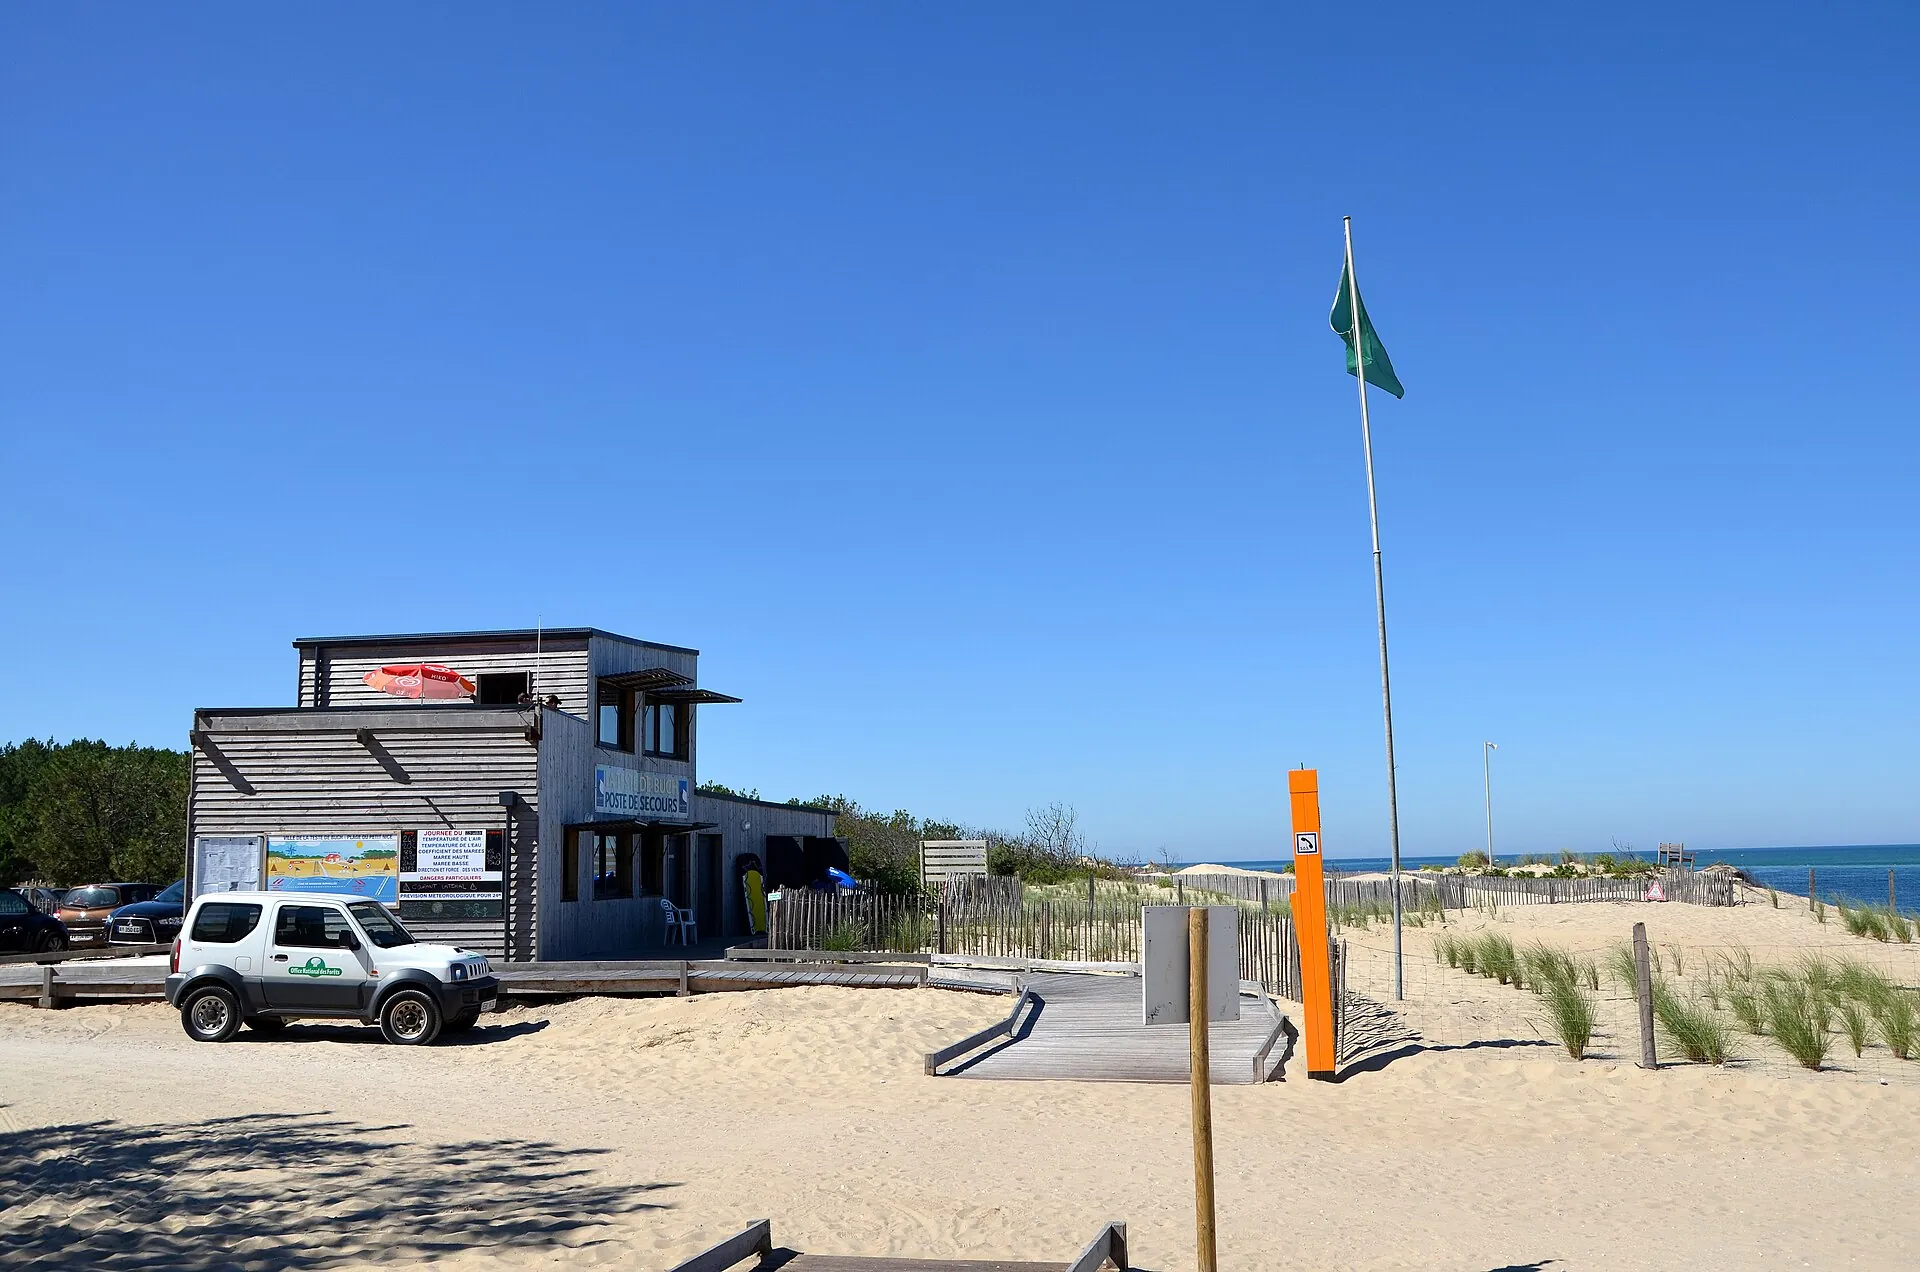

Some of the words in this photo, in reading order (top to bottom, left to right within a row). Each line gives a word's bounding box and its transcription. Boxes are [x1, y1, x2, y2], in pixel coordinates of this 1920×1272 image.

[605, 792, 627, 809] POSTE
[628, 794, 638, 810] DE
[640, 796, 678, 813] SECOURS
